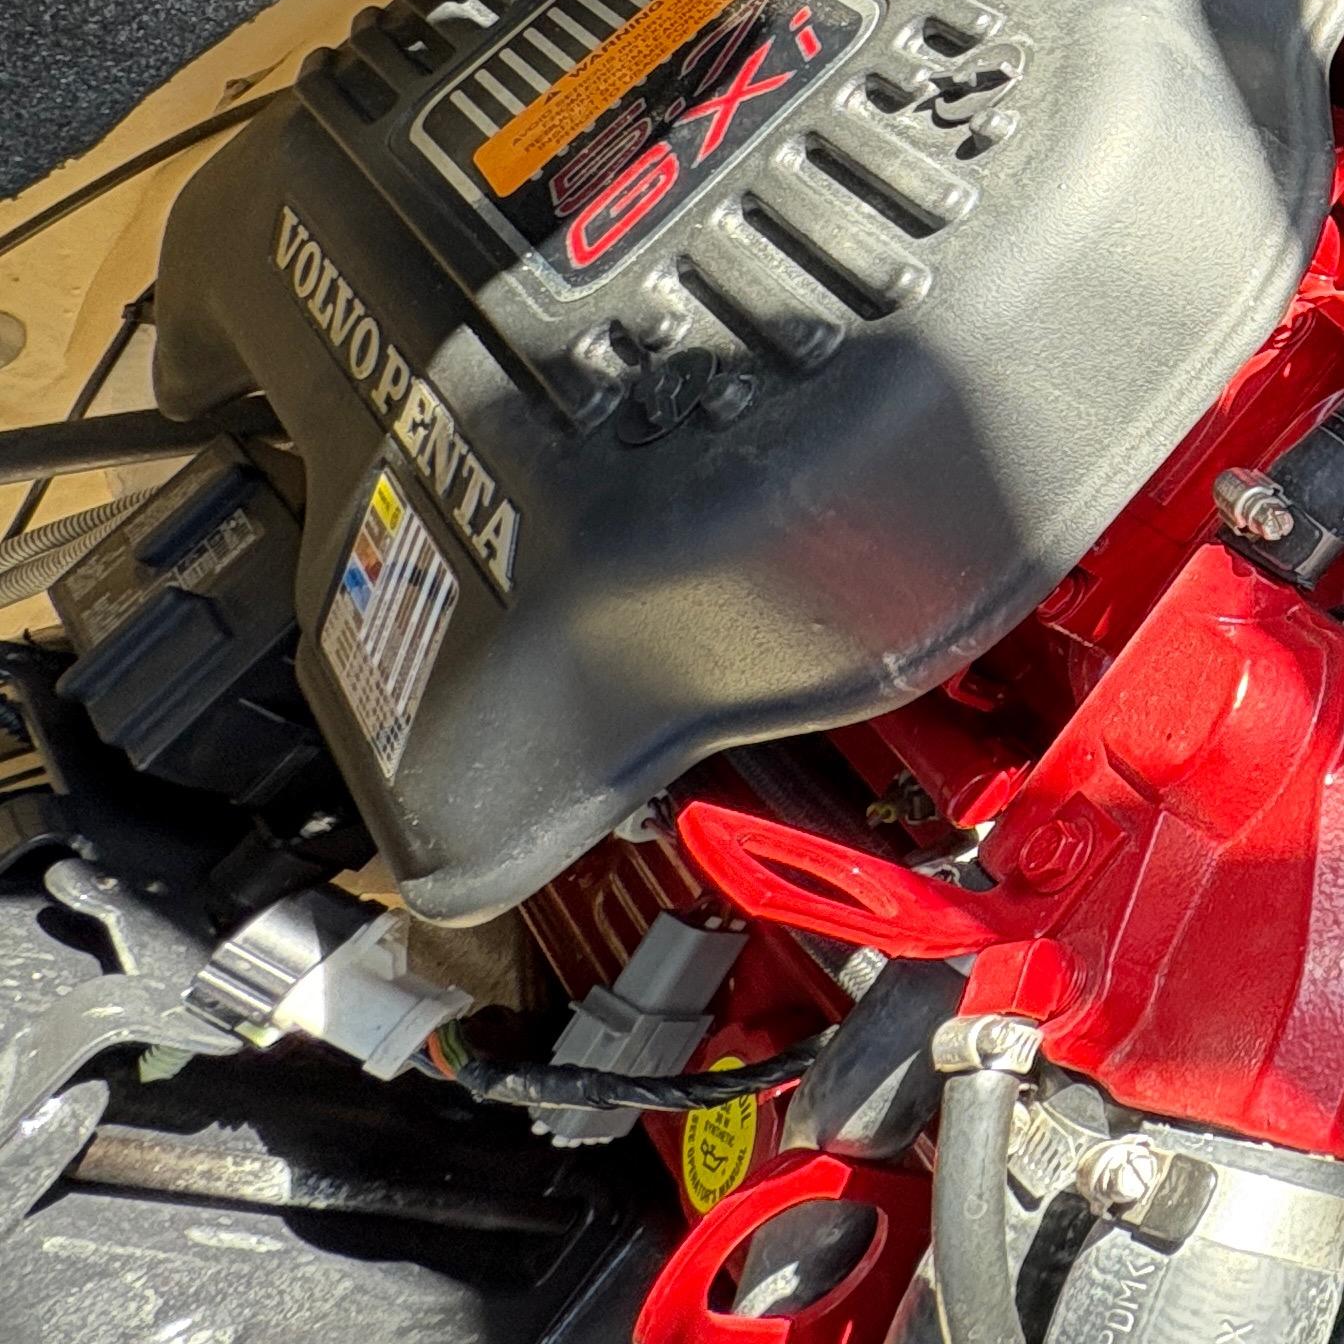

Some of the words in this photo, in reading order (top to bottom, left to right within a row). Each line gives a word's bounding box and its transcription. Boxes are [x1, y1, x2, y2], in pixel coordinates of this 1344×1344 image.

[567, 6, 822, 269] GXi
[274, 207, 387, 379] VOLVO
[367, 344, 518, 592] PENTA
